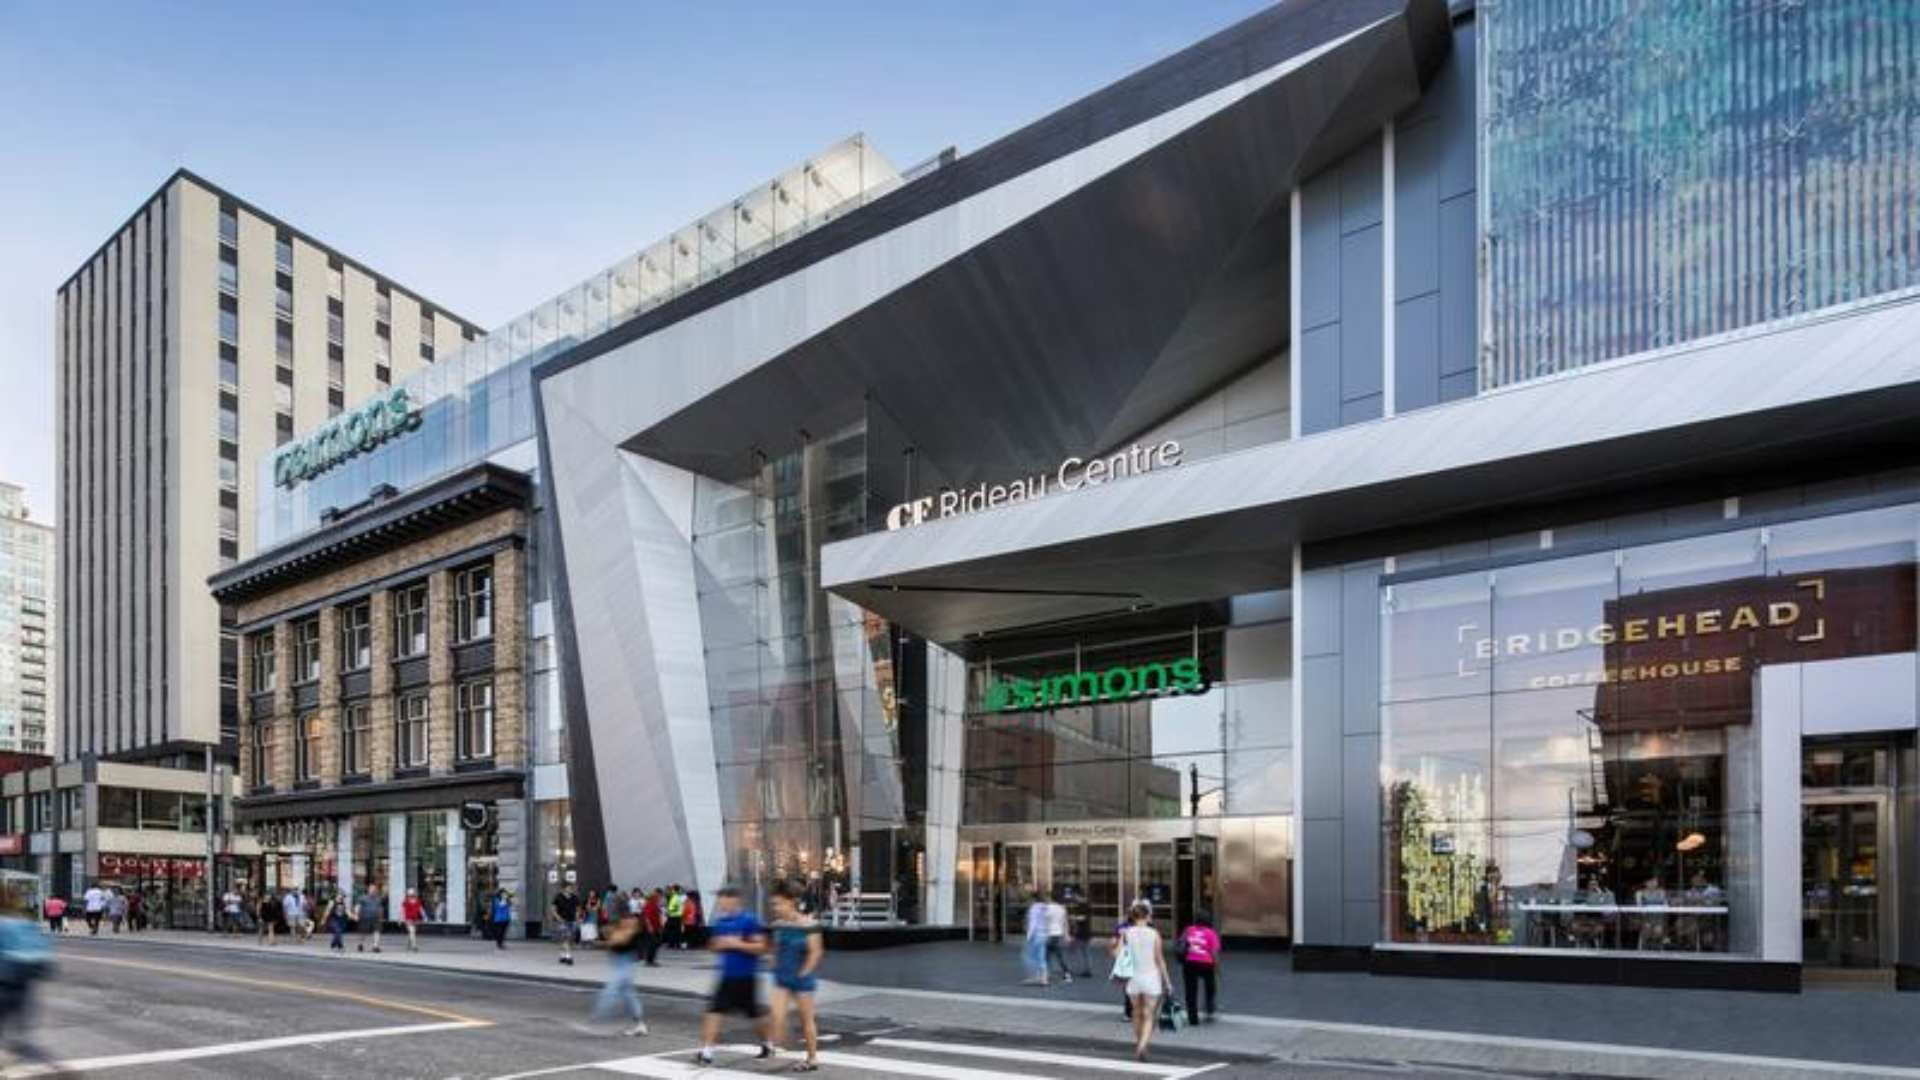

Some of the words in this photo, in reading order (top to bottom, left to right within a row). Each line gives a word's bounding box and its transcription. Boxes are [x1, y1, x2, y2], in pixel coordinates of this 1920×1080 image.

[939, 474, 1046, 519] Rideau
[1057, 440, 1185, 491] Centre
[1475, 601, 1800, 659] BRIDGEHEAD
[1012, 657, 1201, 709] simons
[1529, 656, 1742, 690] COFFEEHOUSE
